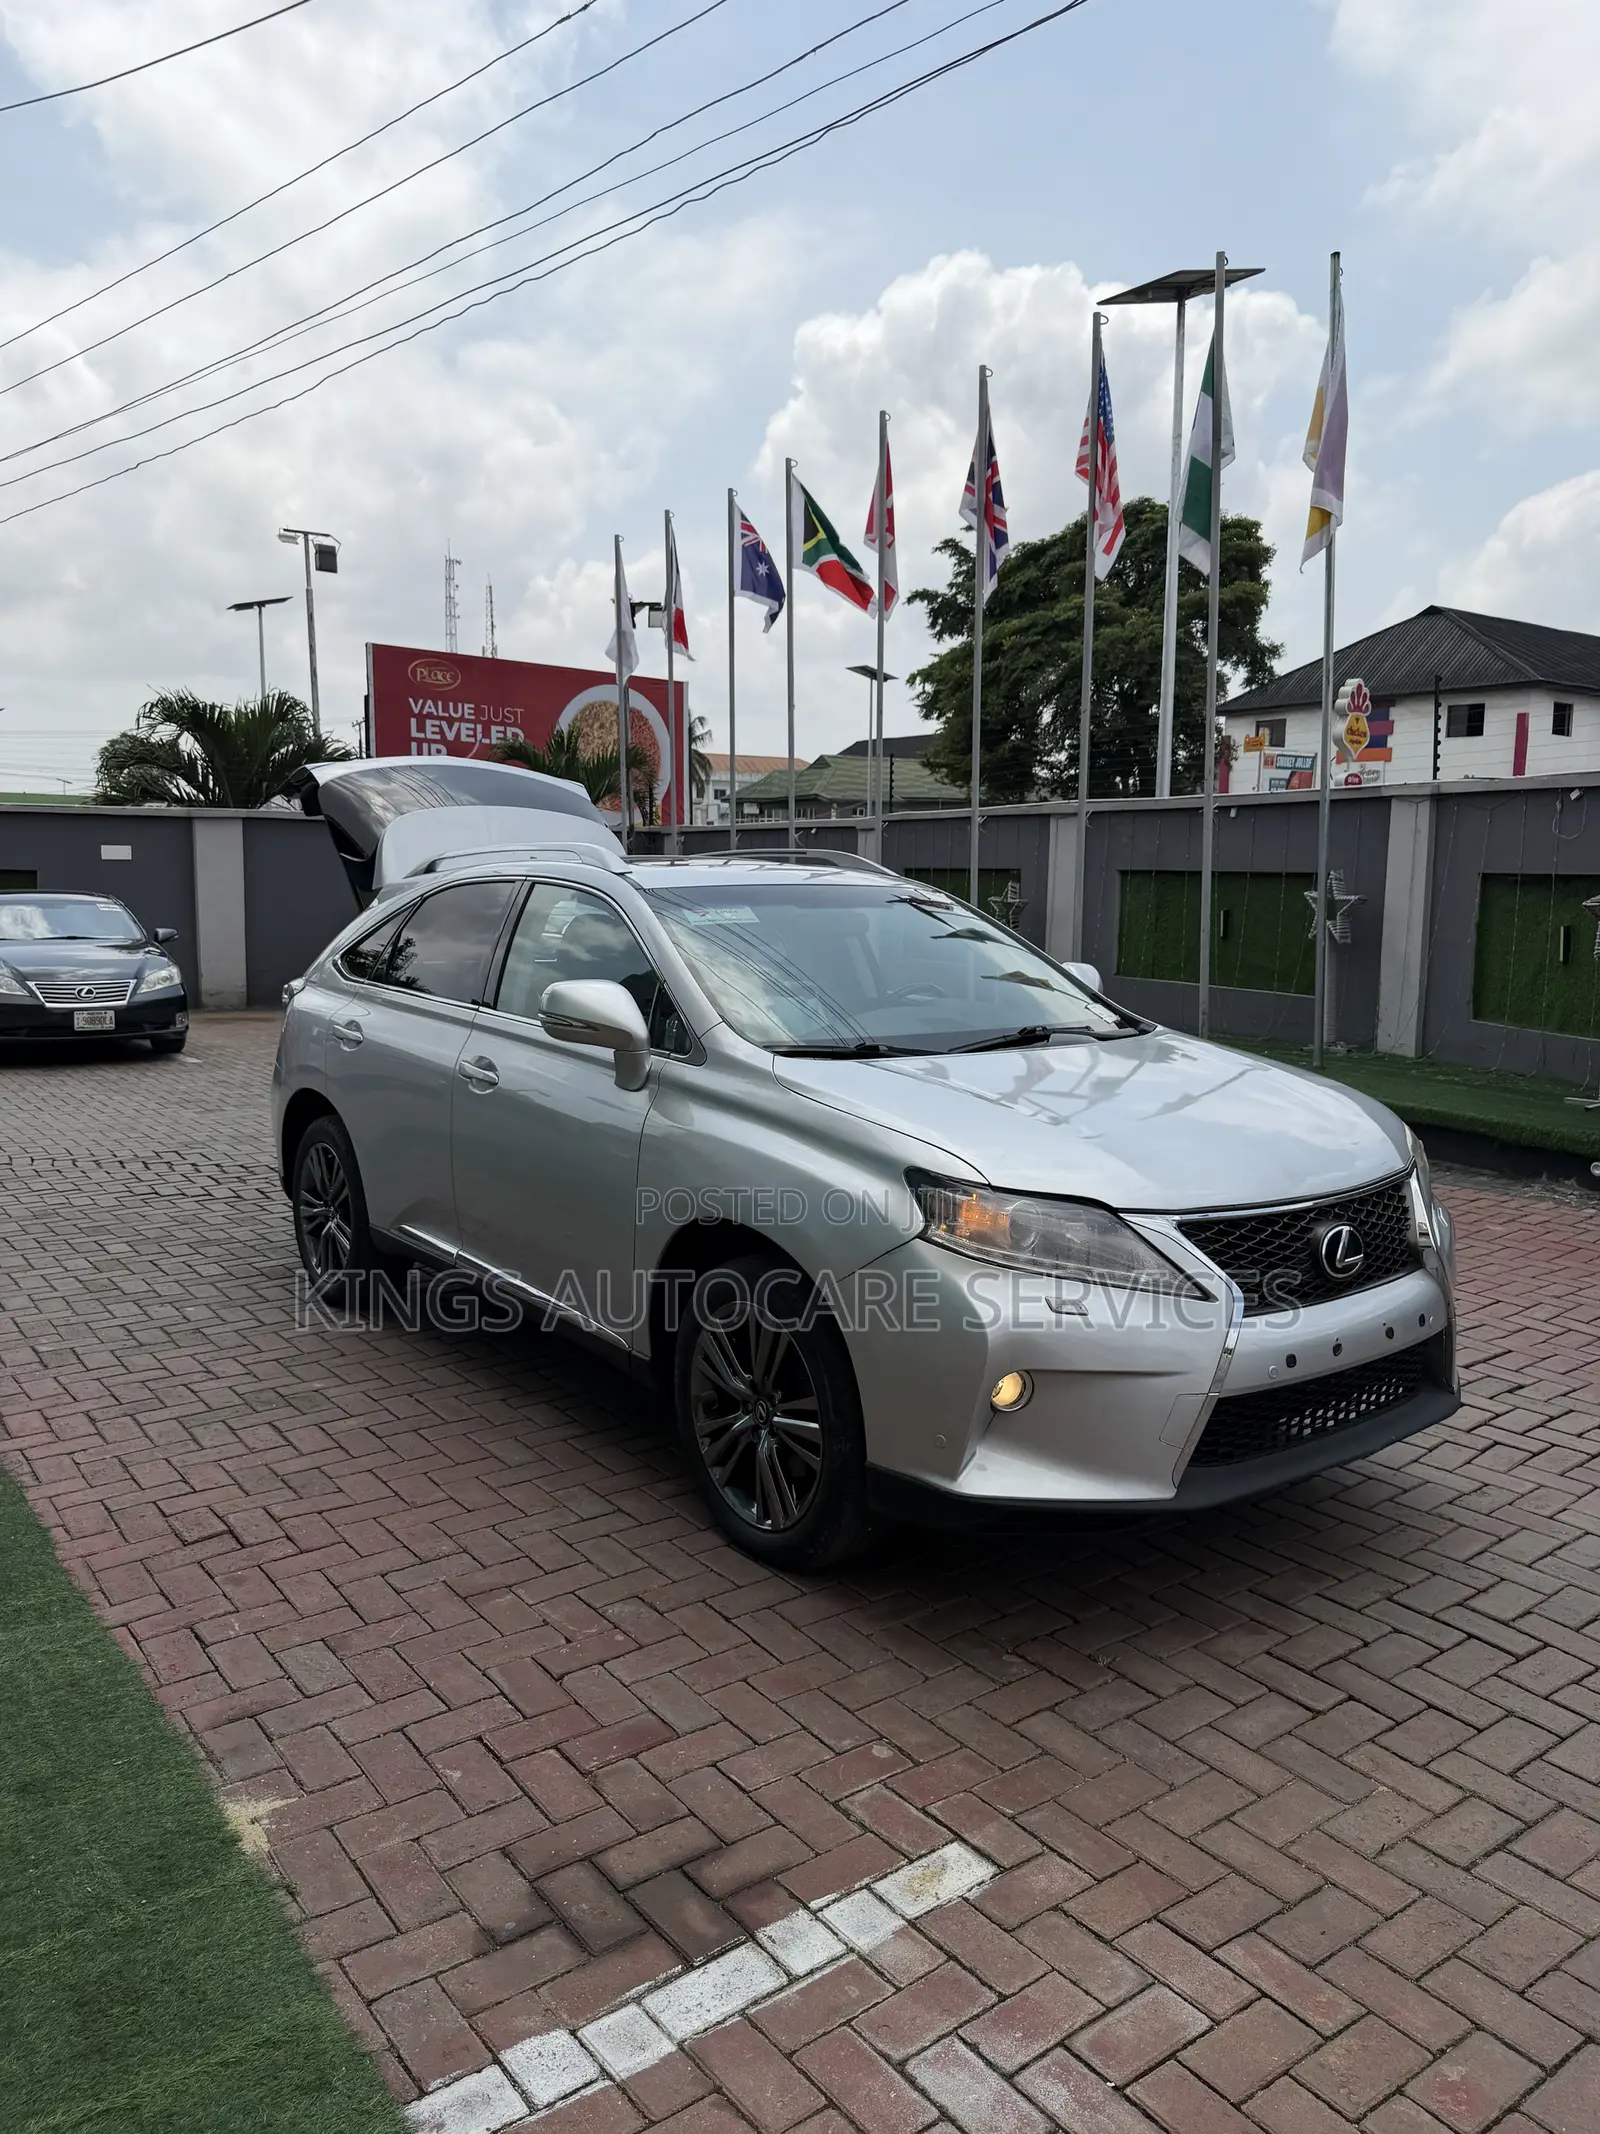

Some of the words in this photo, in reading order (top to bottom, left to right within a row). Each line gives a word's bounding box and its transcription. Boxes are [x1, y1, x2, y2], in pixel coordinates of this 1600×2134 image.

[408, 697, 476, 719] VALUE
[480, 705, 525, 724] JUST
[410, 717, 525, 744] LEVELED
[411, 741, 448, 757] UP
